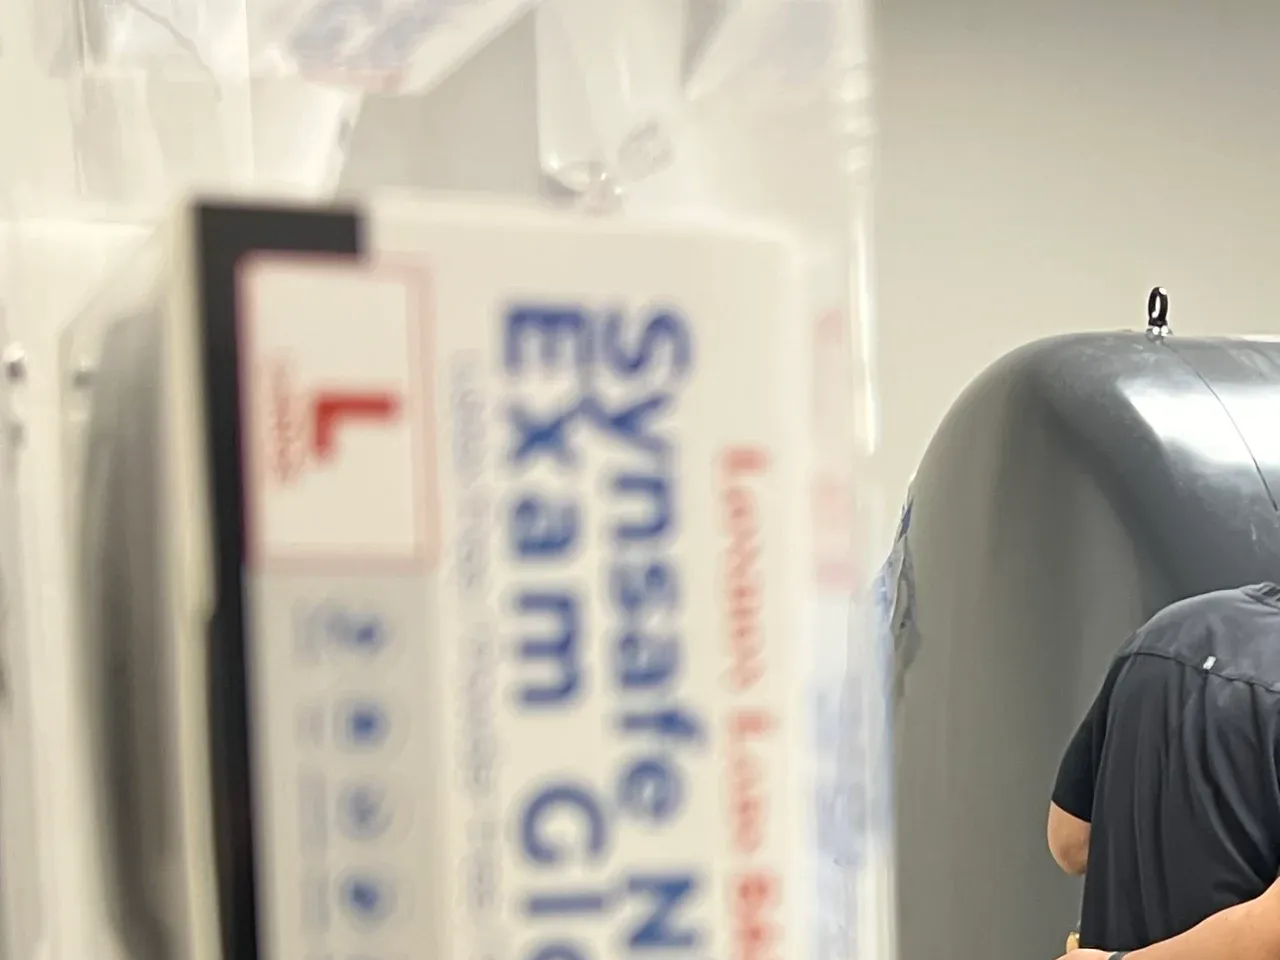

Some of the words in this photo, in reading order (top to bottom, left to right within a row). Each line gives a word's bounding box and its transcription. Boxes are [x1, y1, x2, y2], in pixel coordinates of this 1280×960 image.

[311, 392, 398, 462] L
[505, 304, 591, 710] Exam
[584, 308, 706, 823] Synsafe
